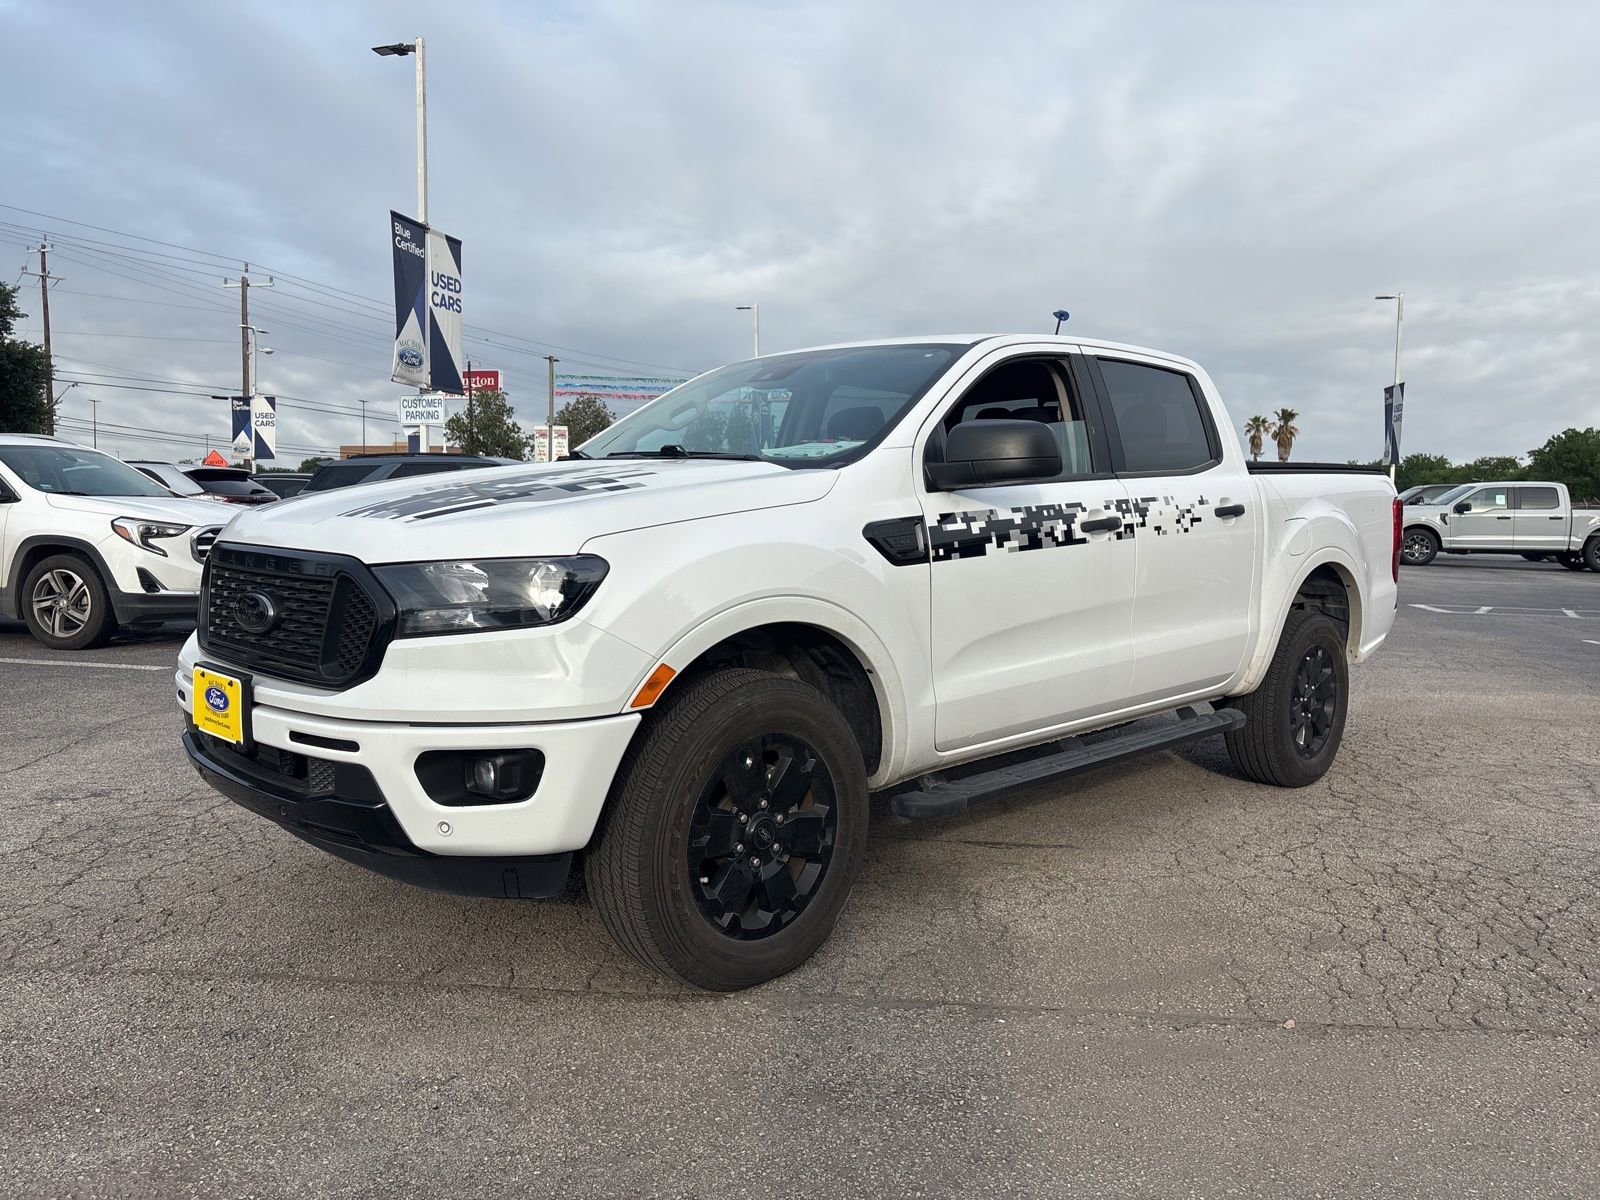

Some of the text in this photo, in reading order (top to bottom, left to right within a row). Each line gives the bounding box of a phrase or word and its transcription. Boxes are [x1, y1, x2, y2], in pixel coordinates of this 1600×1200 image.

[394, 222, 411, 239] Blue
[395, 236, 425, 259] Certified
[431, 270, 461, 294] USED
[431, 291, 462, 314] CARS
[462, 376, 495, 389] ngton
[402, 399, 443, 409] CUSTOMER
[254, 412, 276, 420] USED
[405, 411, 440, 420] PARKING
[254, 420, 276, 428] CARS
